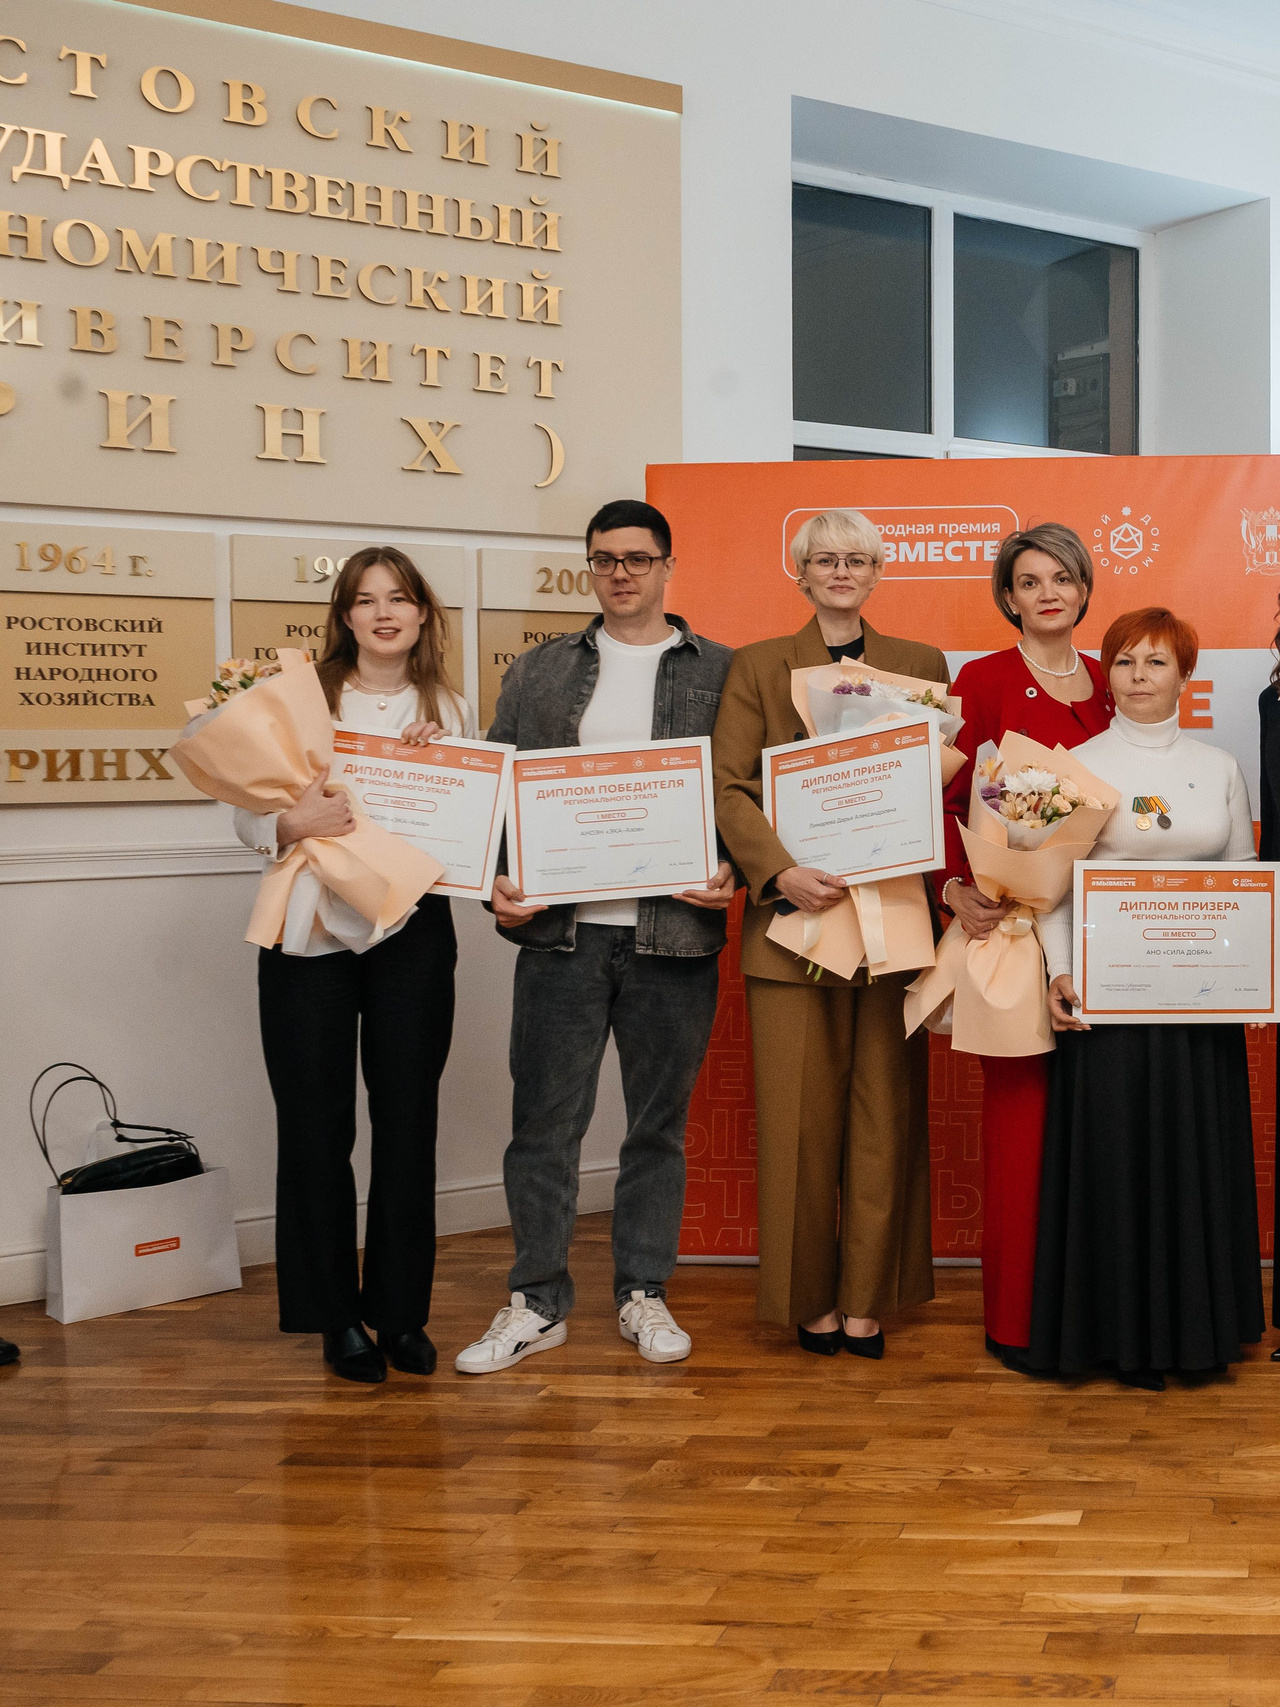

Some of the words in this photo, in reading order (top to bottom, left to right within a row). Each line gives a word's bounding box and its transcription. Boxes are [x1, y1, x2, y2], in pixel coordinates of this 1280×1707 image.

[939, 522, 1000, 538] премия
[15, 541, 116, 575] 1964
[5, 614, 164, 634] РОСТОВСКИЙ
[25, 641, 147, 658] ИНСТИТУТ
[14, 666, 158, 683] НАРОДНОГО
[18, 690, 156, 707] ХОЗЯЙСТВА
[343, 763, 405, 780] ДИПЛОМ
[407, 772, 465, 788] ПРИЗЕРА
[801, 770, 850, 790] ДИПЛОМ
[853, 759, 903, 778] ПРИЗЕРА
[355, 777, 424, 792] РЕГИОНАЛЬНОГО
[425, 786, 451, 795] ЭТАПА
[536, 786, 595, 801] ДИПЛОМ
[598, 778, 685, 794] ПОБЕДИТЕЛЯ
[811, 778, 870, 795] РЕГИОНАЛЬНОГО
[870, 773, 892, 783] ЭТАПА
[563, 795, 632, 806] РЕГИОНАЛЬНОГО
[633, 792, 658, 801] ЭТАПА
[844, 795, 867, 804] МЕСТО
[1118, 901, 1179, 912] ДИПЛОМ
[1182, 901, 1240, 911] ПРИЗЕРА
